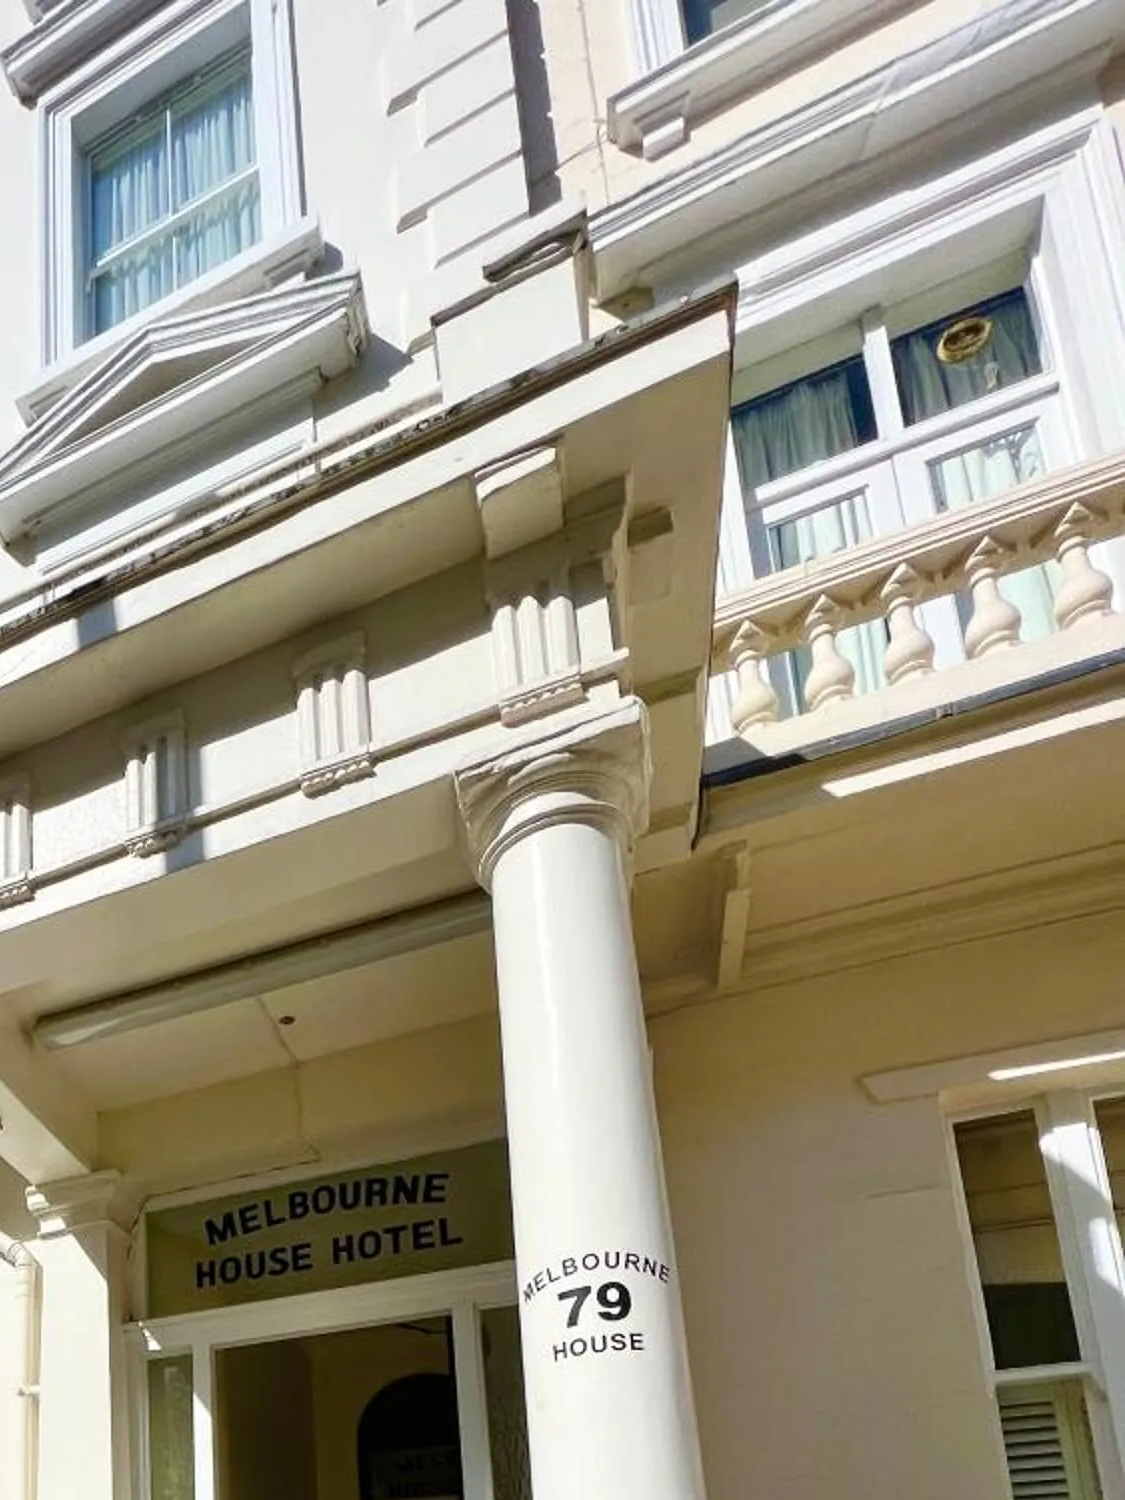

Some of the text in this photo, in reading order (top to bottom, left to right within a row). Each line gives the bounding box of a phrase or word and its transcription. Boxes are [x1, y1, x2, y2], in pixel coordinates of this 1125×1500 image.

[203, 1173, 451, 1246] MELBOURNE
[195, 1217, 464, 1289] HOUSE HOTEL
[523, 1251, 671, 1303] MELBOURNE
[557, 1281, 632, 1329] 79
[552, 1333, 645, 1363] HOUSE
